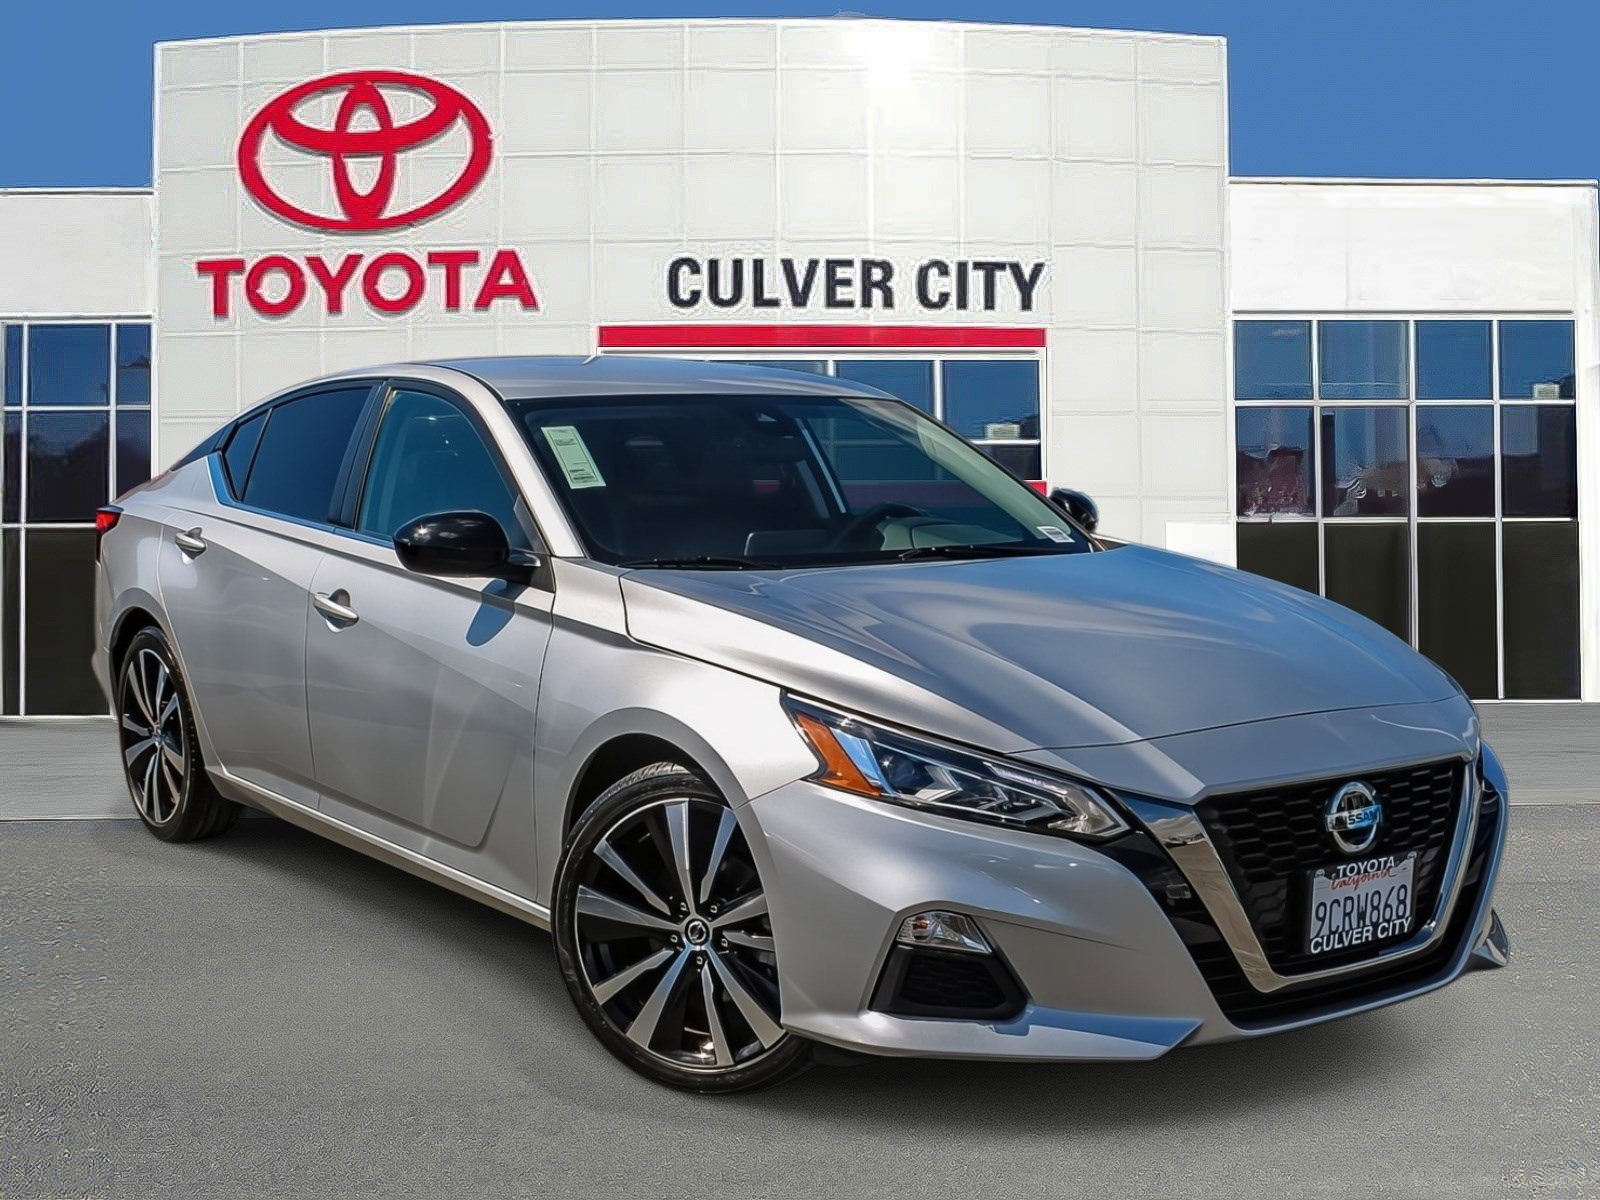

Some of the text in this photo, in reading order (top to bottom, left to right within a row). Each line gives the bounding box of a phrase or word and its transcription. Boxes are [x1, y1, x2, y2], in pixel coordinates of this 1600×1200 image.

[197, 249, 539, 320] TOYOTA
[667, 256, 1046, 311] CULVER CITY
[1336, 856, 1395, 878] TOYOTA
[1310, 916, 1412, 954] CULVER CITY
[1315, 884, 1408, 938] 9CRW868
